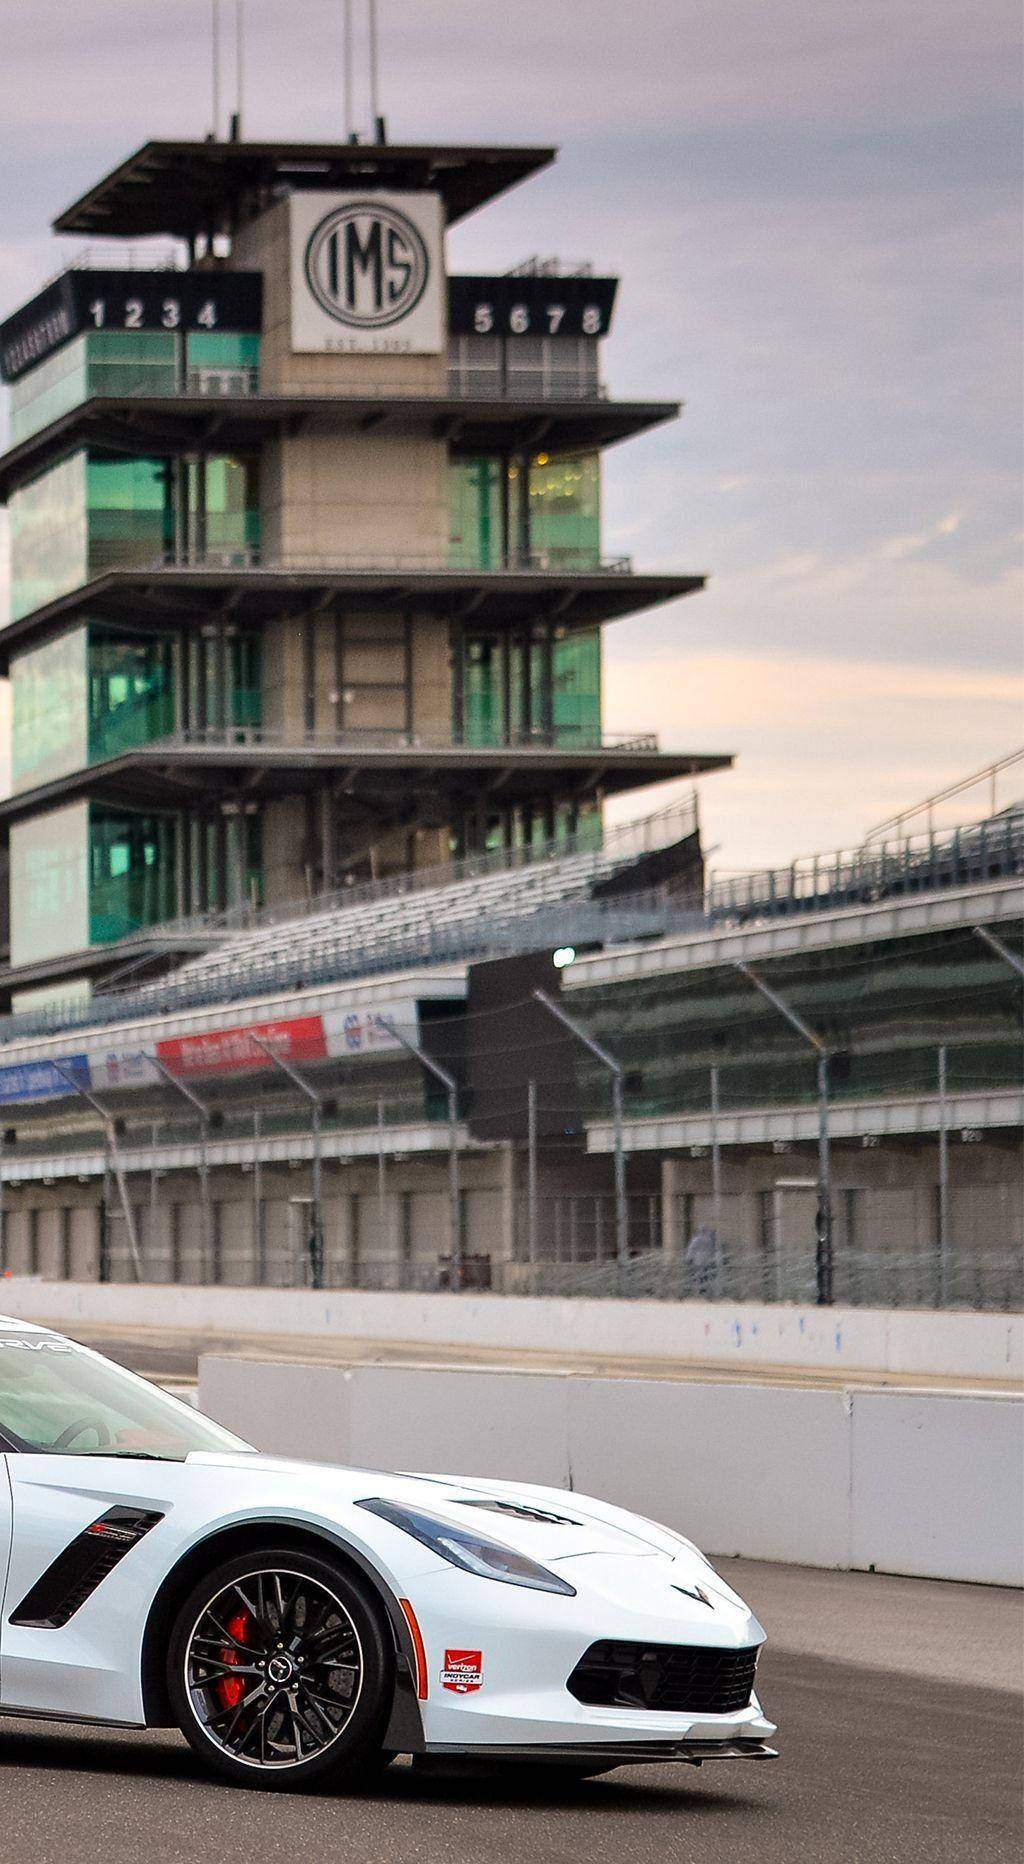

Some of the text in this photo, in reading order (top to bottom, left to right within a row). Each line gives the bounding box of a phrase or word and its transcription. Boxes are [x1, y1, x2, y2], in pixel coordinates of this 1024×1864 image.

[329, 220, 412, 310] IMS
[90, 299, 218, 329] 1 2 3 4
[474, 303, 601, 334] 5 6 7 8
[448, 1663, 477, 1672] verizon
